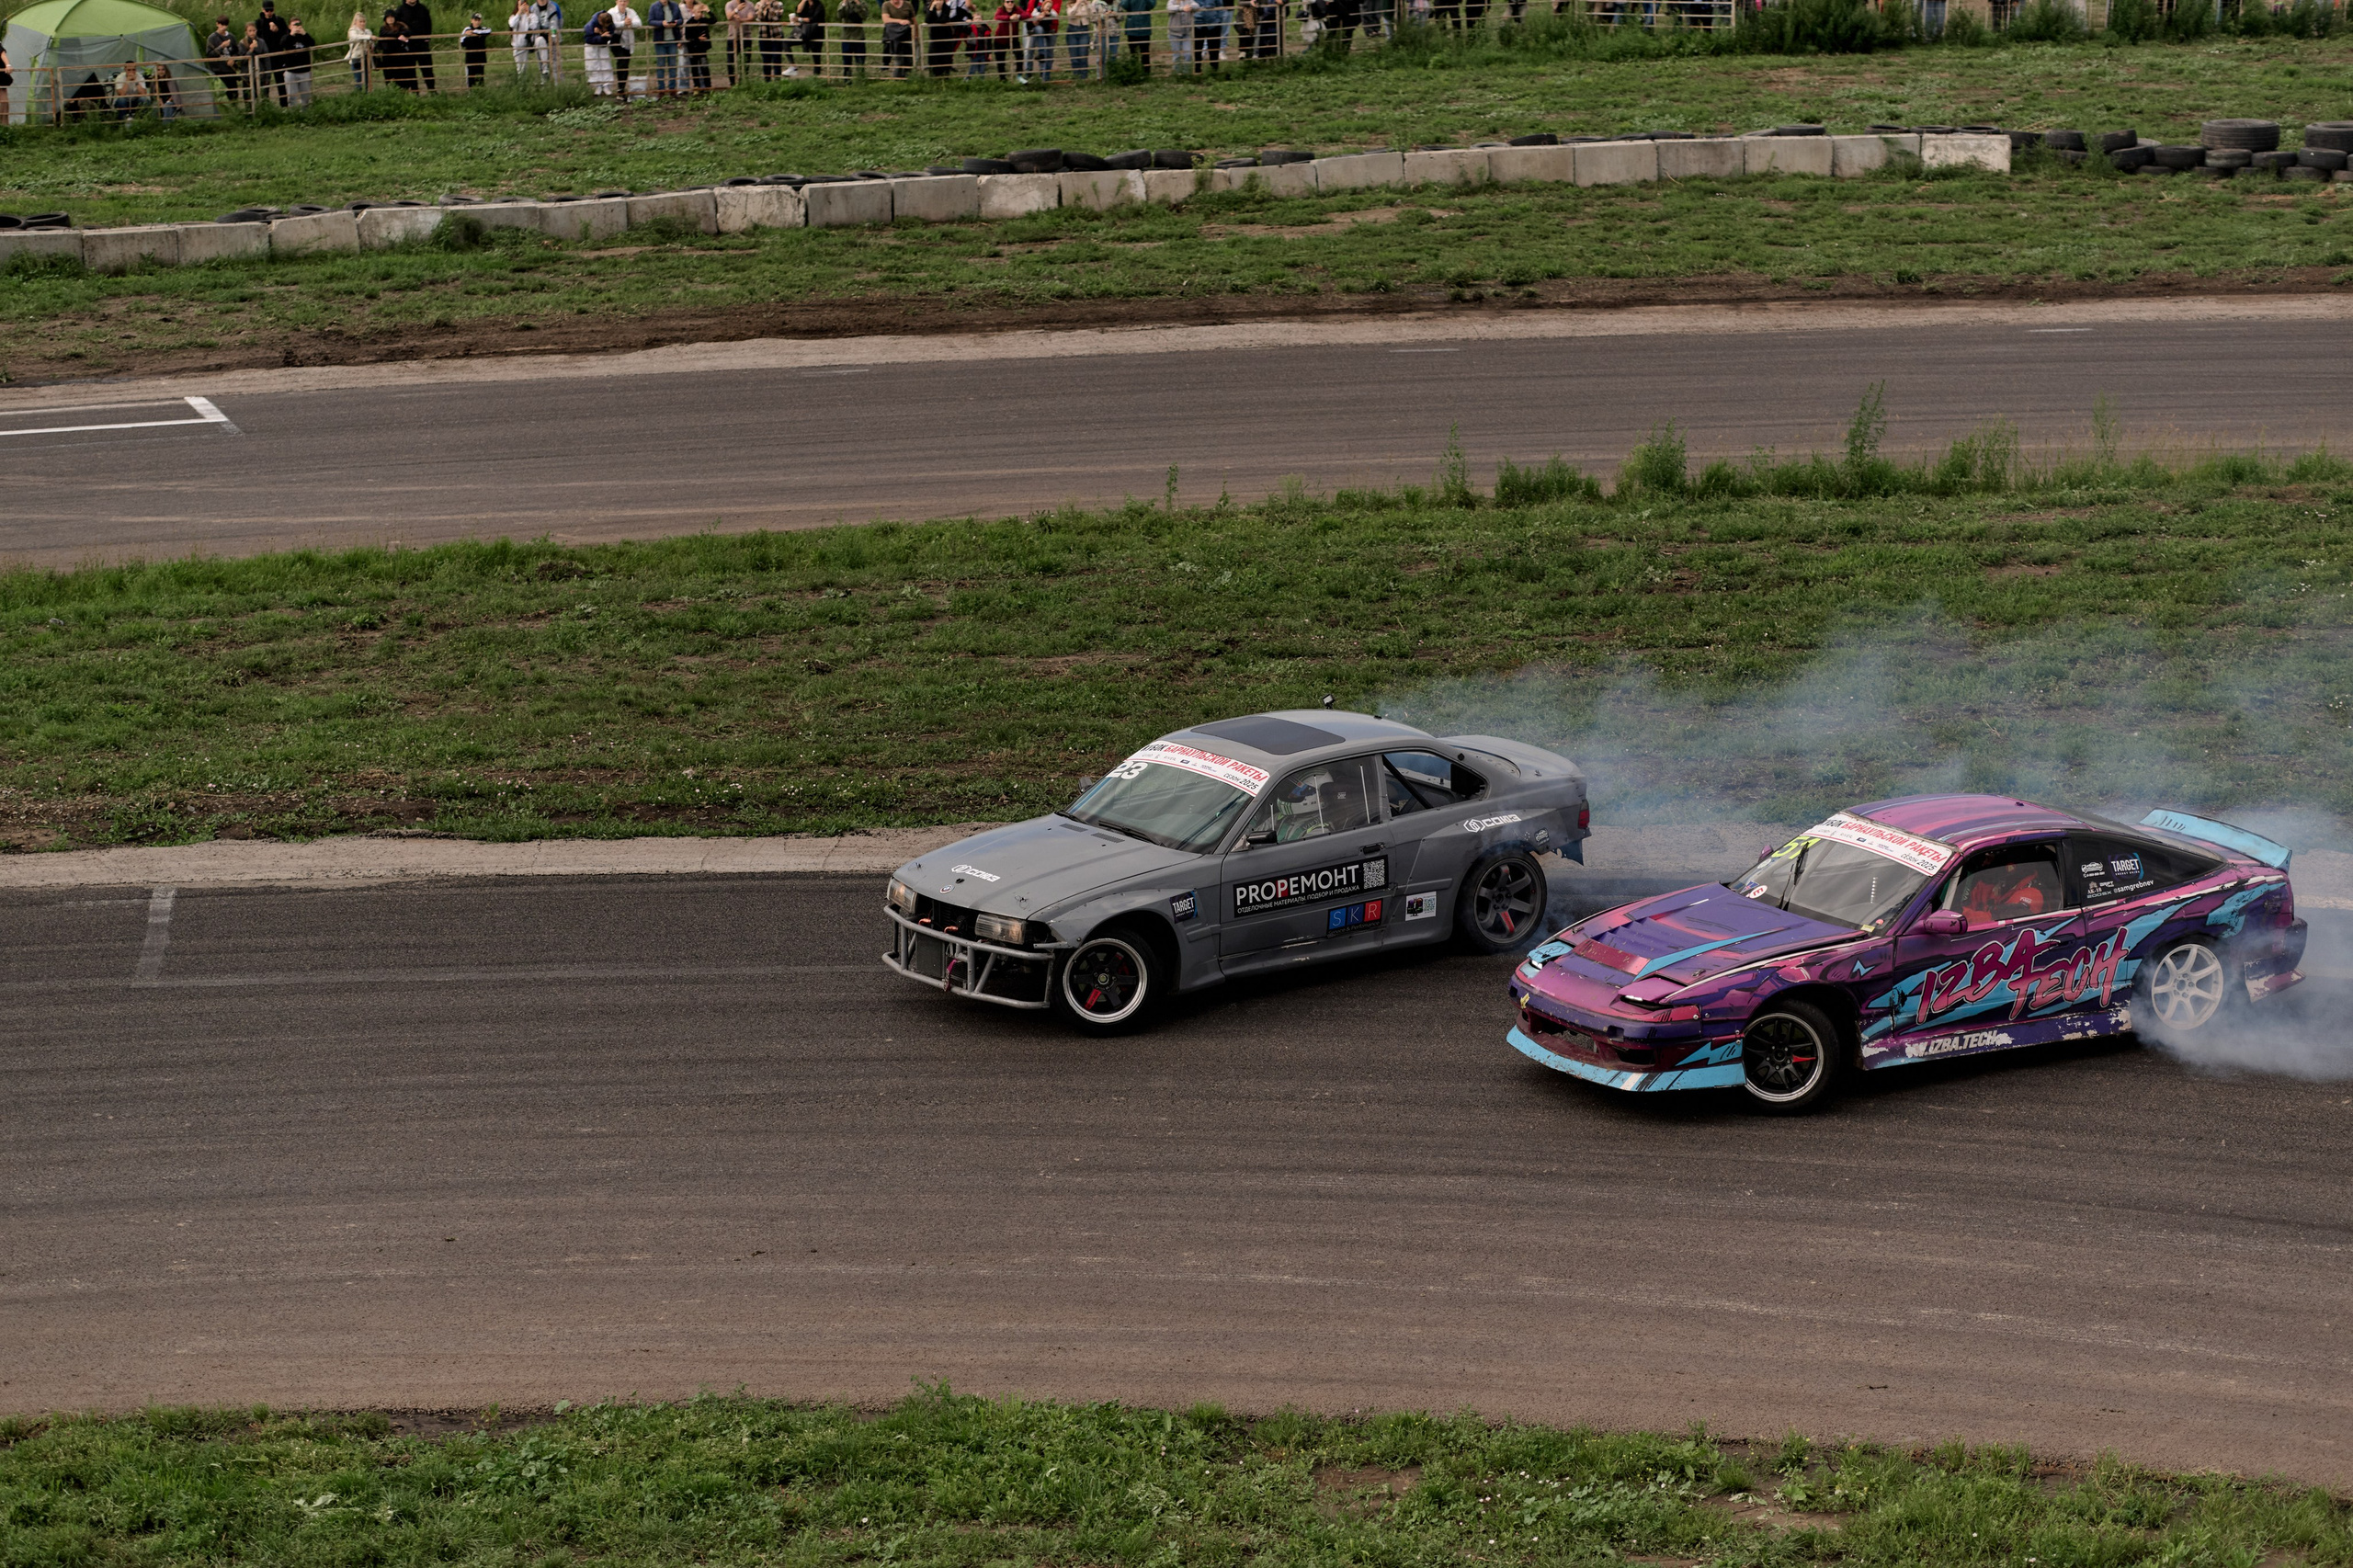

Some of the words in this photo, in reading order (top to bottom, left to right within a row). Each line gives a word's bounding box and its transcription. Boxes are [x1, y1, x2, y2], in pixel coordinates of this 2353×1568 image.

[1106, 761, 1148, 779] 23
[1227, 761, 1267, 782] РАКЕТЫ
[1239, 778, 1259, 790] 2025
[1841, 822, 1910, 846] БАРНАУЛЬСКОЙ
[1904, 841, 1948, 862] РАКЕТЫ
[1917, 859, 1937, 871] 2025
[2111, 859, 2140, 871] TARGET
[2114, 880, 2154, 893] @samgrebnev
[1172, 897, 1194, 914] TARGET
[1237, 901, 1273, 914] ОТДЕЛОЧНЫЕ
[1307, 891, 1329, 901] ПОДБОР
[1334, 884, 1359, 894] ПРОДАЖА
[1333, 903, 1377, 926] SKR
[1916, 928, 2061, 1024] IZBA
[2007, 926, 2130, 1020] TECH
